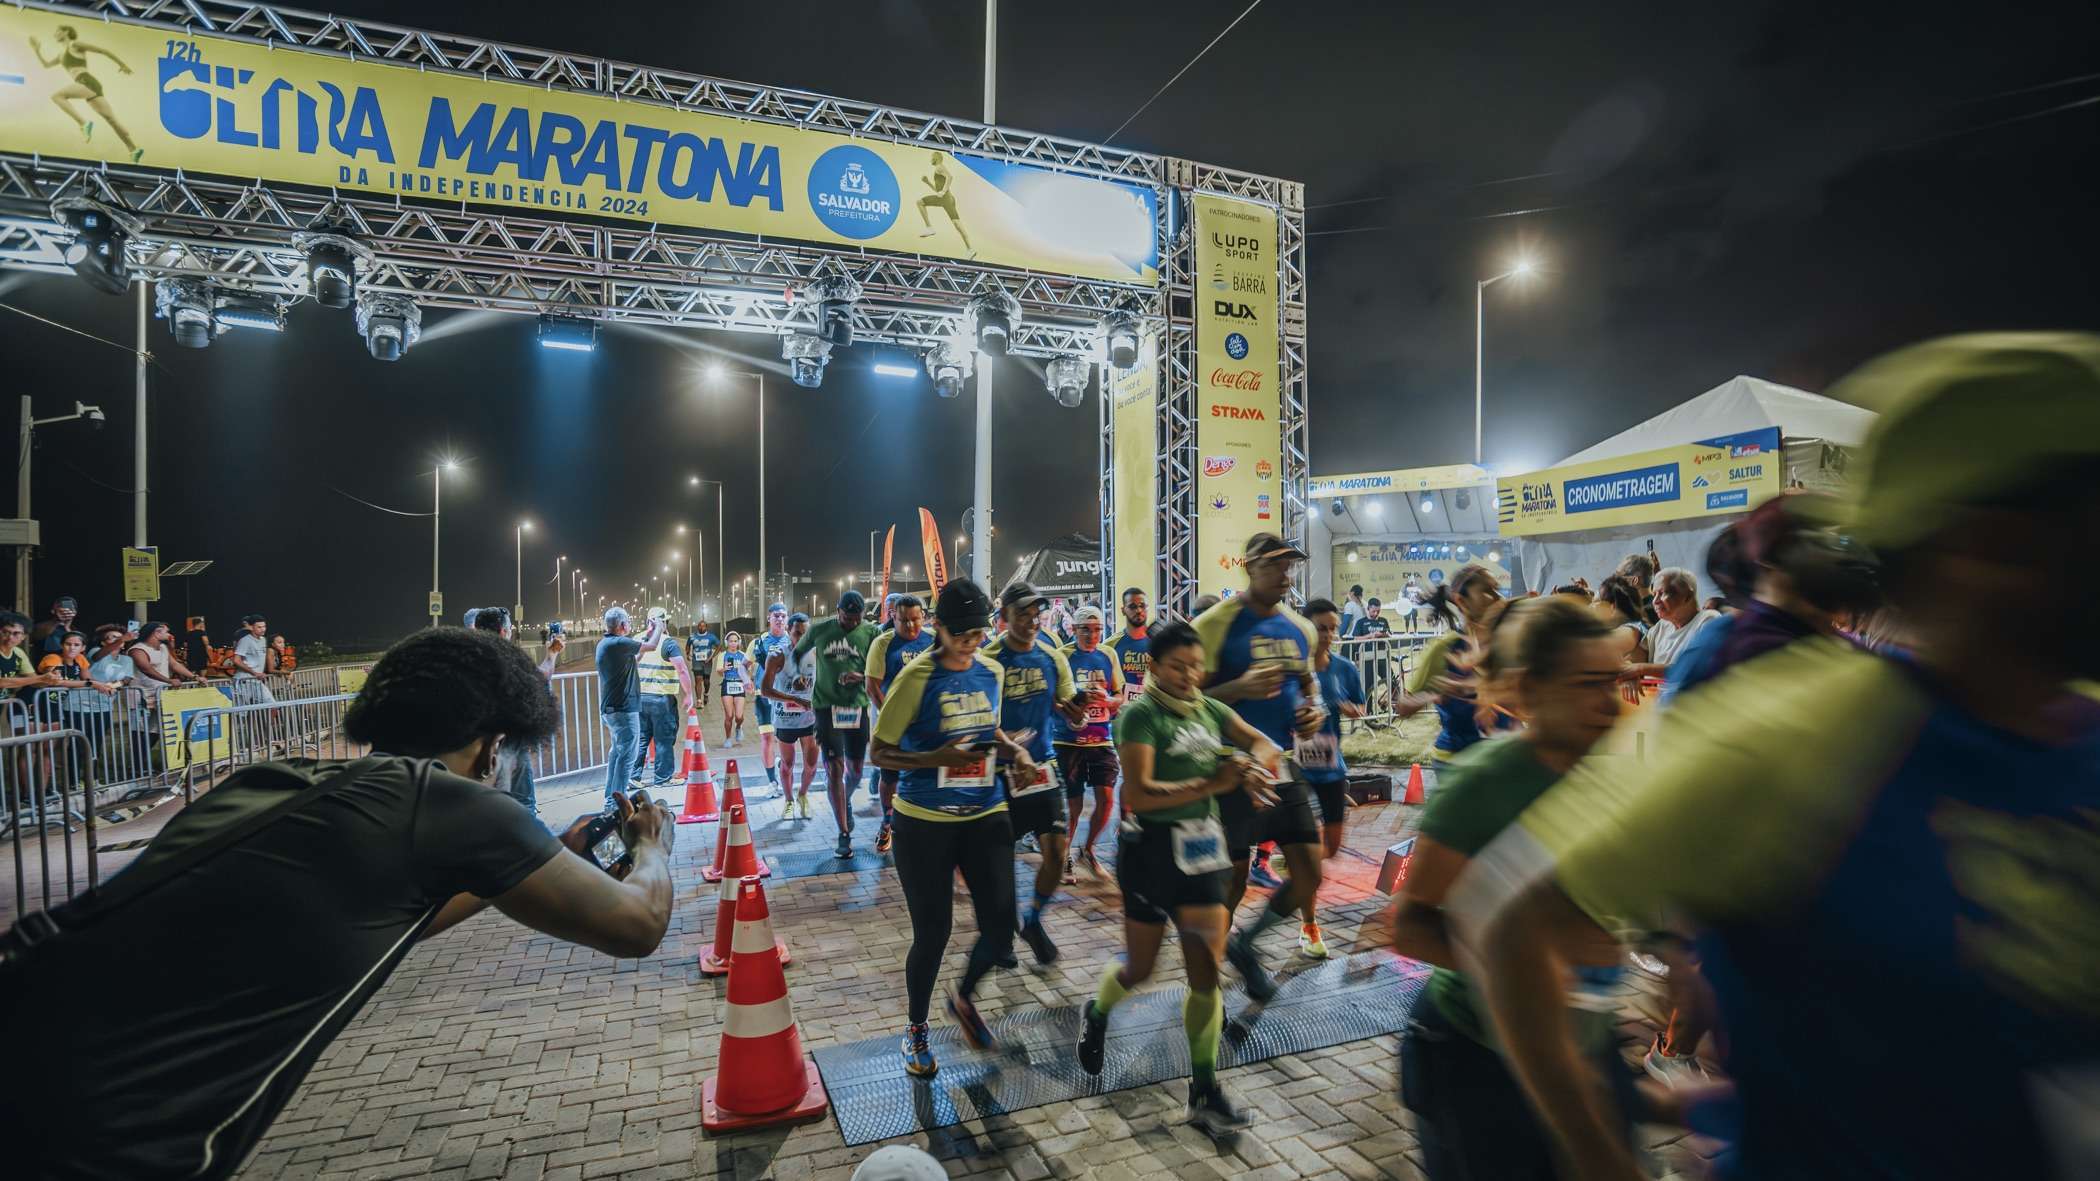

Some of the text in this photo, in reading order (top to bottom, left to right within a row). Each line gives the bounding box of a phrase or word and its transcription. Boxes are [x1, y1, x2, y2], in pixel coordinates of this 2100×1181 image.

[165, 40, 202, 63] 12h
[418, 96, 785, 212] MARATONA
[339, 165, 649, 217] DA INDEPENDENCIA 2024
[819, 193, 890, 215] SALVADOR
[828, 209, 880, 222] PREFEITURA
[1212, 232, 1259, 251] LUPO
[1225, 249, 1260, 261] SPORT
[1233, 276, 1266, 295] BARRA
[1214, 300, 1257, 321] DUX
[1211, 405, 1265, 421] STRAVA
[1729, 464, 1763, 480] SALTUR
[1339, 476, 1392, 489] MARATONA
[1567, 471, 1675, 506] CRONOMETRAGEM
[1521, 499, 1557, 512] MARATONA
